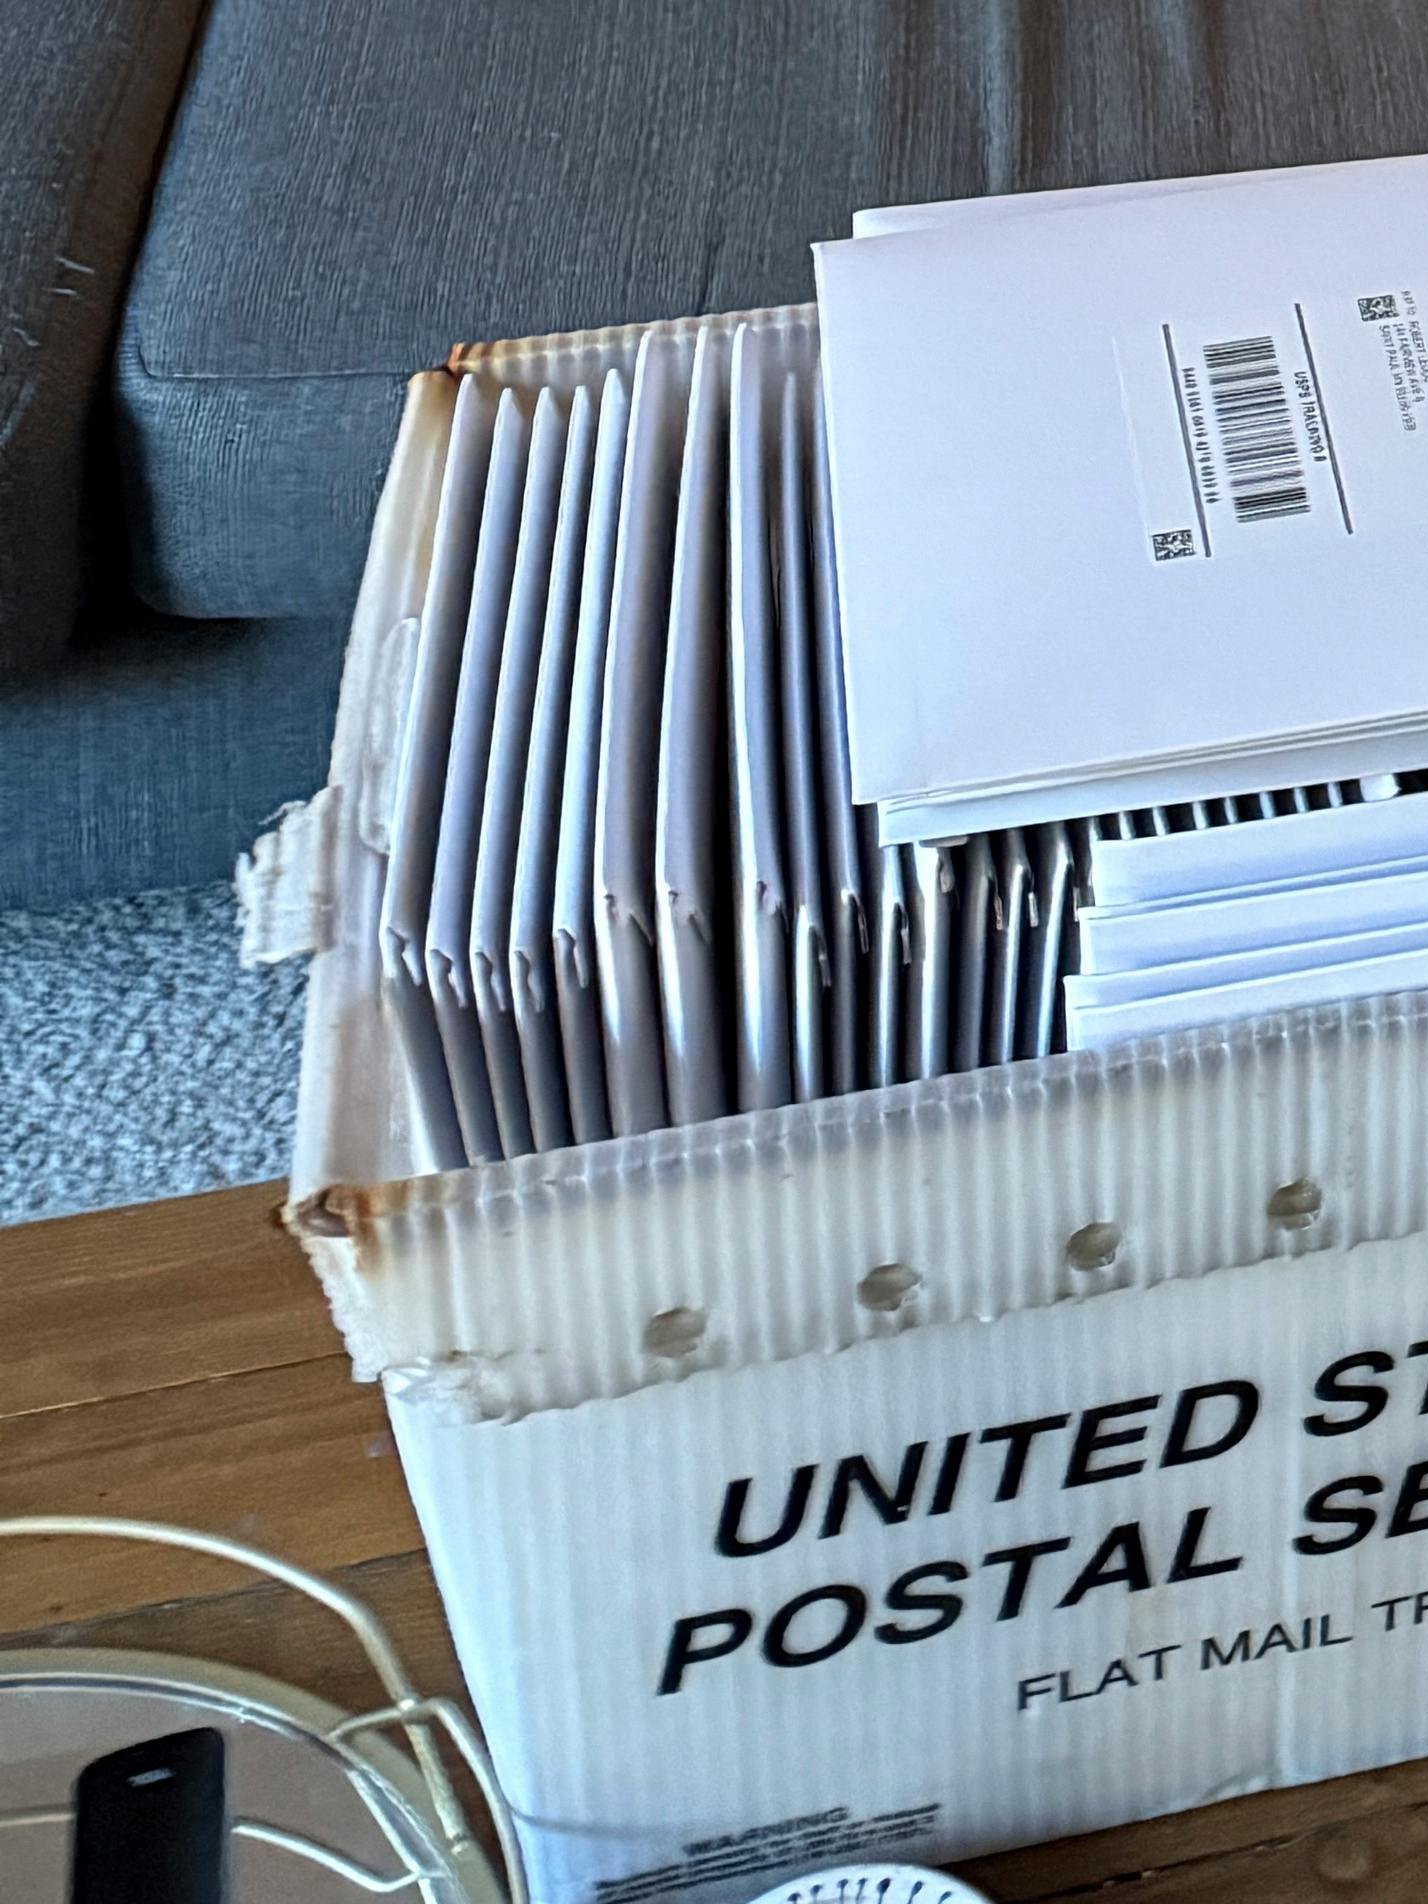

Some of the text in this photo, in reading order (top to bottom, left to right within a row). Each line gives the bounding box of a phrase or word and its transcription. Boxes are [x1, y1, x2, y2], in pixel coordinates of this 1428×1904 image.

[713, 1378, 1262, 1559] UNITED
[656, 1505, 1244, 1697] POSTAL
[1016, 1644, 1183, 1712] FLAT
[1199, 1614, 1355, 1672] MAIL
